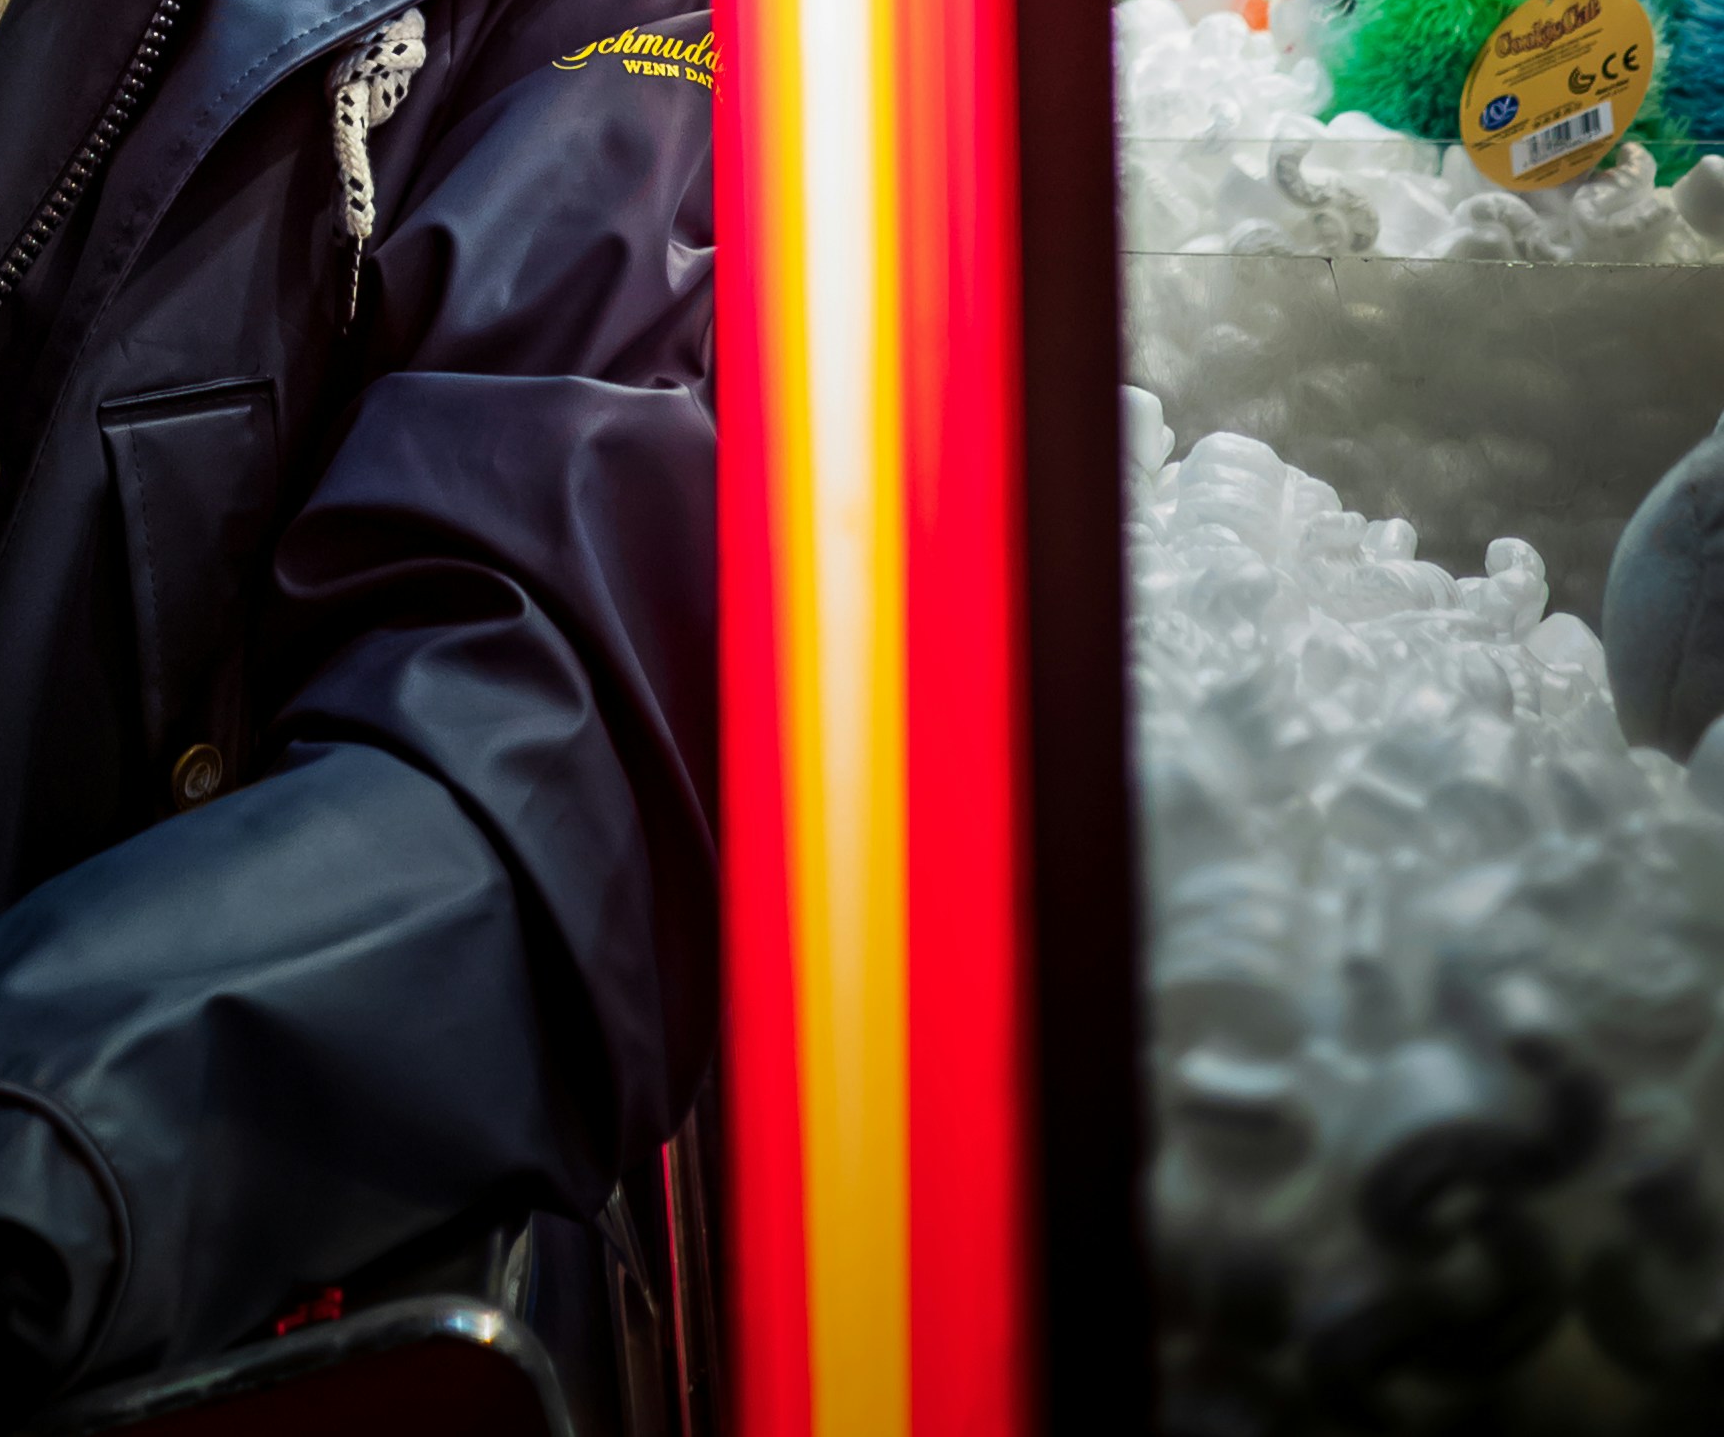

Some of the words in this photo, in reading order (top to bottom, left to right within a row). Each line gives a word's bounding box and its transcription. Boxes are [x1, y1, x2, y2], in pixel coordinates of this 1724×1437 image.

[562, 26, 724, 73] chmudd
[623, 59, 680, 78] WENN
[685, 67, 714, 90] DAT
